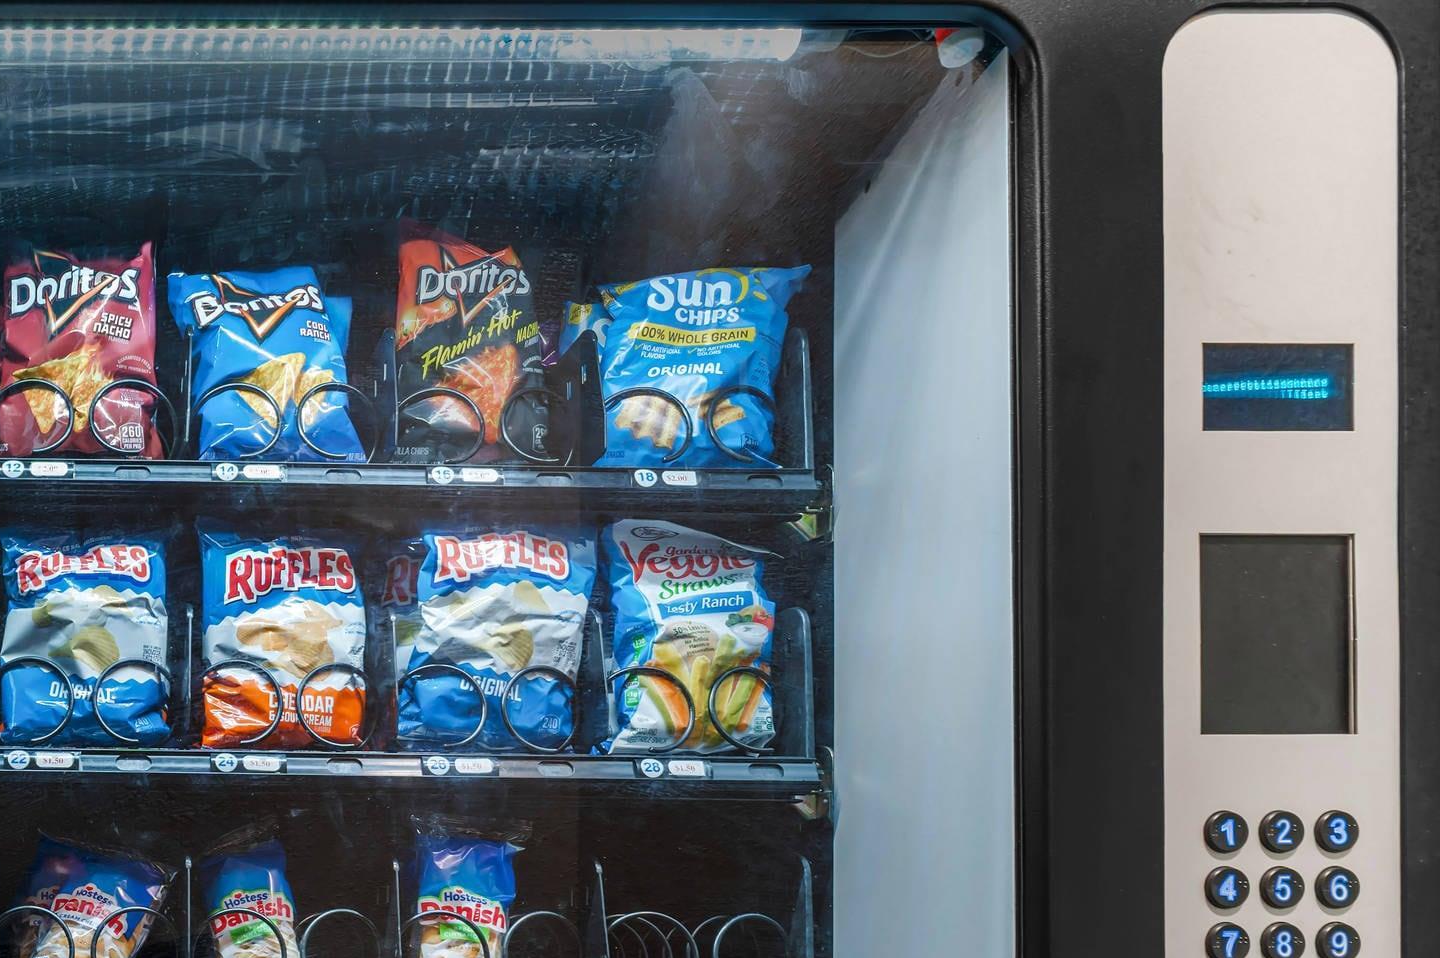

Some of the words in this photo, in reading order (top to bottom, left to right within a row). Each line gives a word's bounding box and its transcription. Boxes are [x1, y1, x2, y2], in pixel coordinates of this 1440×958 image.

[11, 266, 138, 314] Doritos
[419, 264, 531, 303] Doritos
[647, 276, 732, 311] Sun
[101, 313, 132, 326] SPICY
[306, 320, 328, 332] COOL
[675, 307, 740, 326] CHIPS
[93, 322, 131, 339] NACHO
[299, 327, 331, 341] RANCH
[668, 330, 708, 344] WHOLE
[711, 329, 749, 342] GRAIN
[421, 327, 485, 380] Flamin'
[487, 309, 522, 339] Hot
[641, 351, 666, 360] FLAVORS
[651, 345, 681, 355] ARTIFICIAL
[647, 362, 723, 377] ORIGINAL
[122, 425, 142, 438] 260
[638, 472, 654, 482] 18
[666, 474, 688, 482] $2.00
[620, 541, 755, 583] Veggie
[227, 549, 354, 601] RUFFLES
[658, 573, 737, 600] Straws
[701, 594, 745, 609] Ranch
[542, 716, 558, 728] 240
[1221, 819, 1235, 846] 1
[1275, 819, 1293, 844] 2
[1329, 818, 1348, 845] 3
[76, 888, 114, 906] Hostess
[444, 891, 488, 905] Hostess
[1219, 874, 1238, 901] 4
[1274, 875, 1292, 901] 5
[1330, 875, 1348, 901] 6
[224, 892, 269, 909] Hostess
[420, 902, 505, 929] Danish
[1222, 930, 1240, 958] 7
[1276, 931, 1293, 957] 8
[1331, 932, 1348, 957] 9
